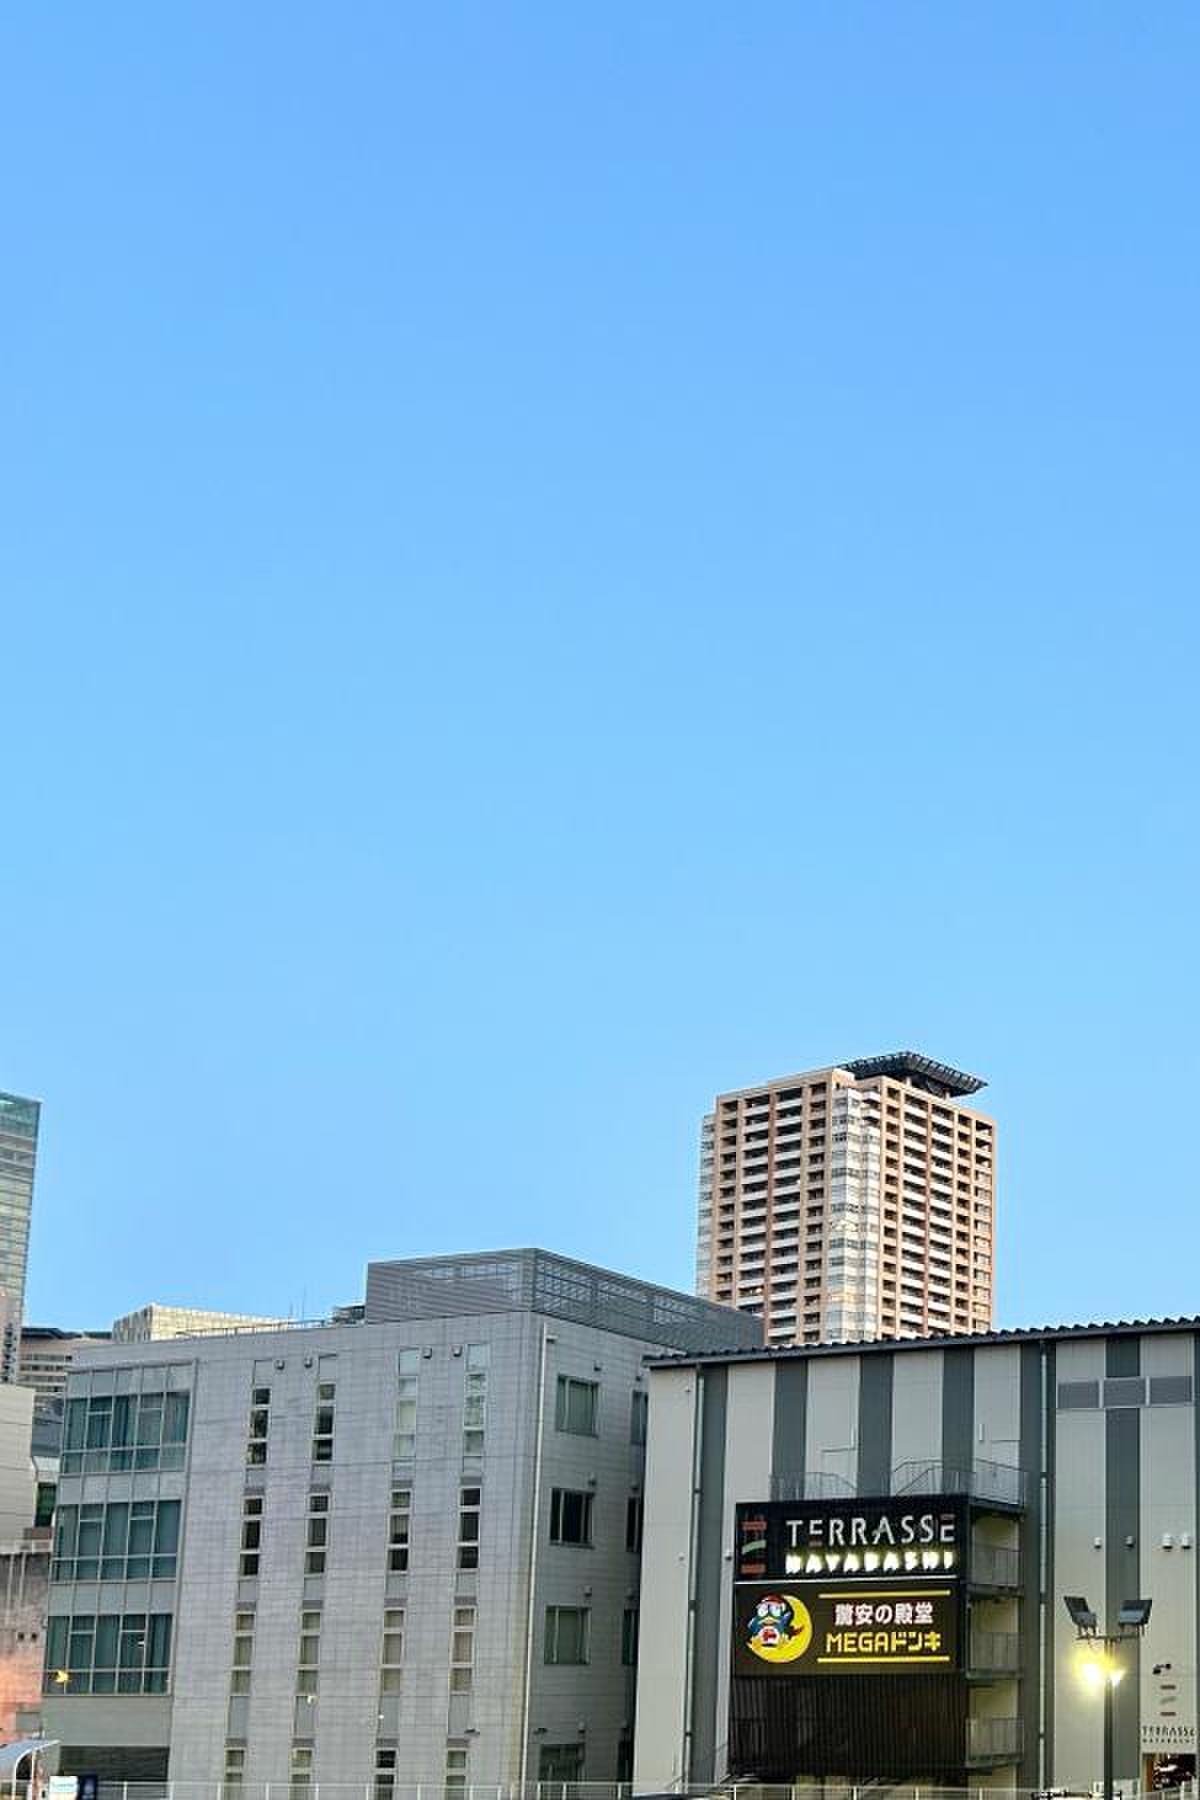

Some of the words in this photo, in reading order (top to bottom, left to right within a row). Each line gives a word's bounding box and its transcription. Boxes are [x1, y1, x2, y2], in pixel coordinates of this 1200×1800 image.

[785, 1514, 955, 1547] TERRASSE
[835, 1603, 933, 1626] 驚安の殿堂
[826, 1632, 941, 1653] MEGAドンキ
